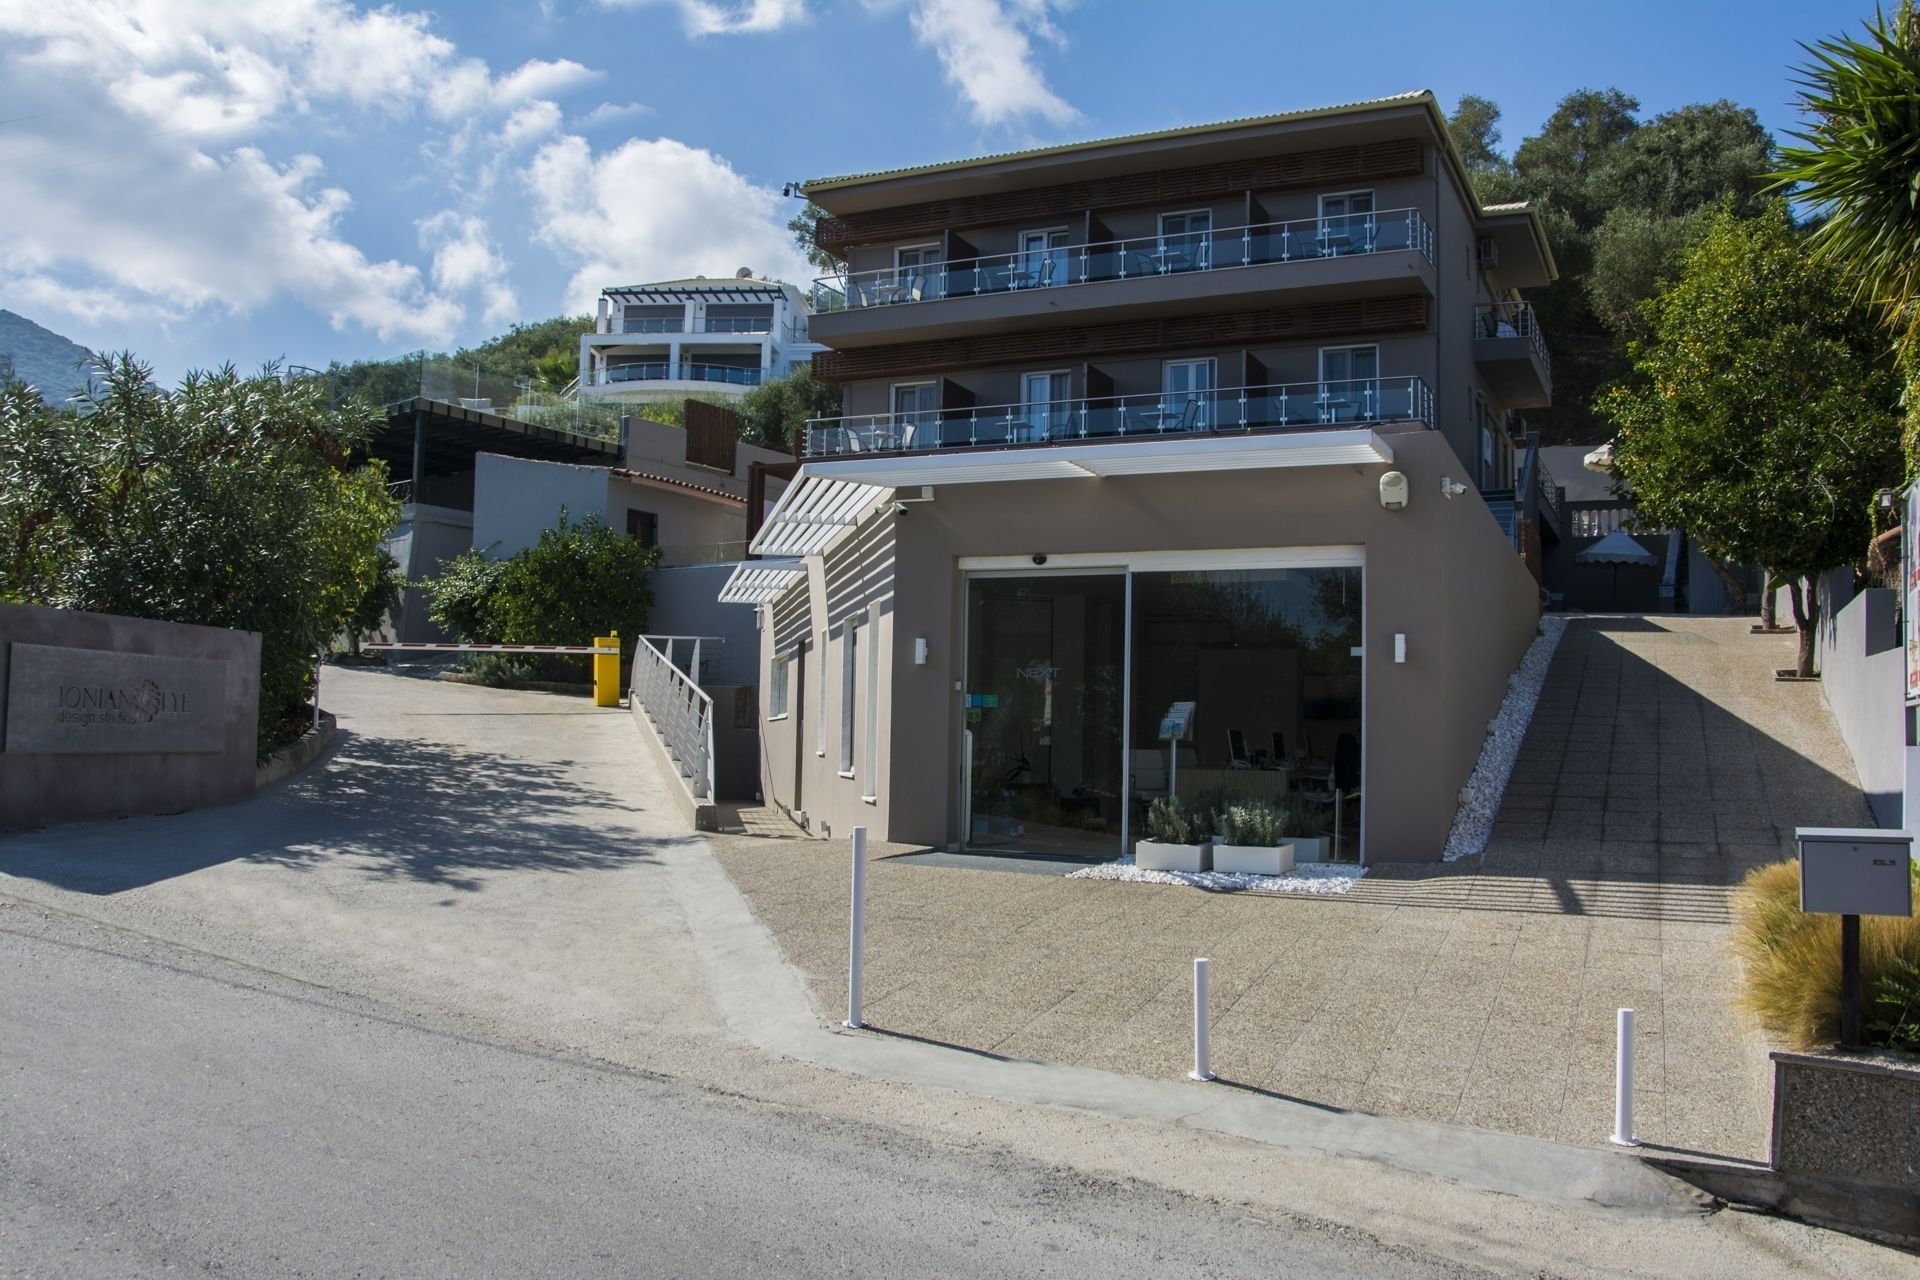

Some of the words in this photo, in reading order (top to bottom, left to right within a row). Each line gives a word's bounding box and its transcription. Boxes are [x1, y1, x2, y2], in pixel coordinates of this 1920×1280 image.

[1016, 667, 1062, 679] NEXT
[58, 686, 131, 709] IONIAN
[161, 692, 191, 713] EYE
[57, 709, 95, 727] design
